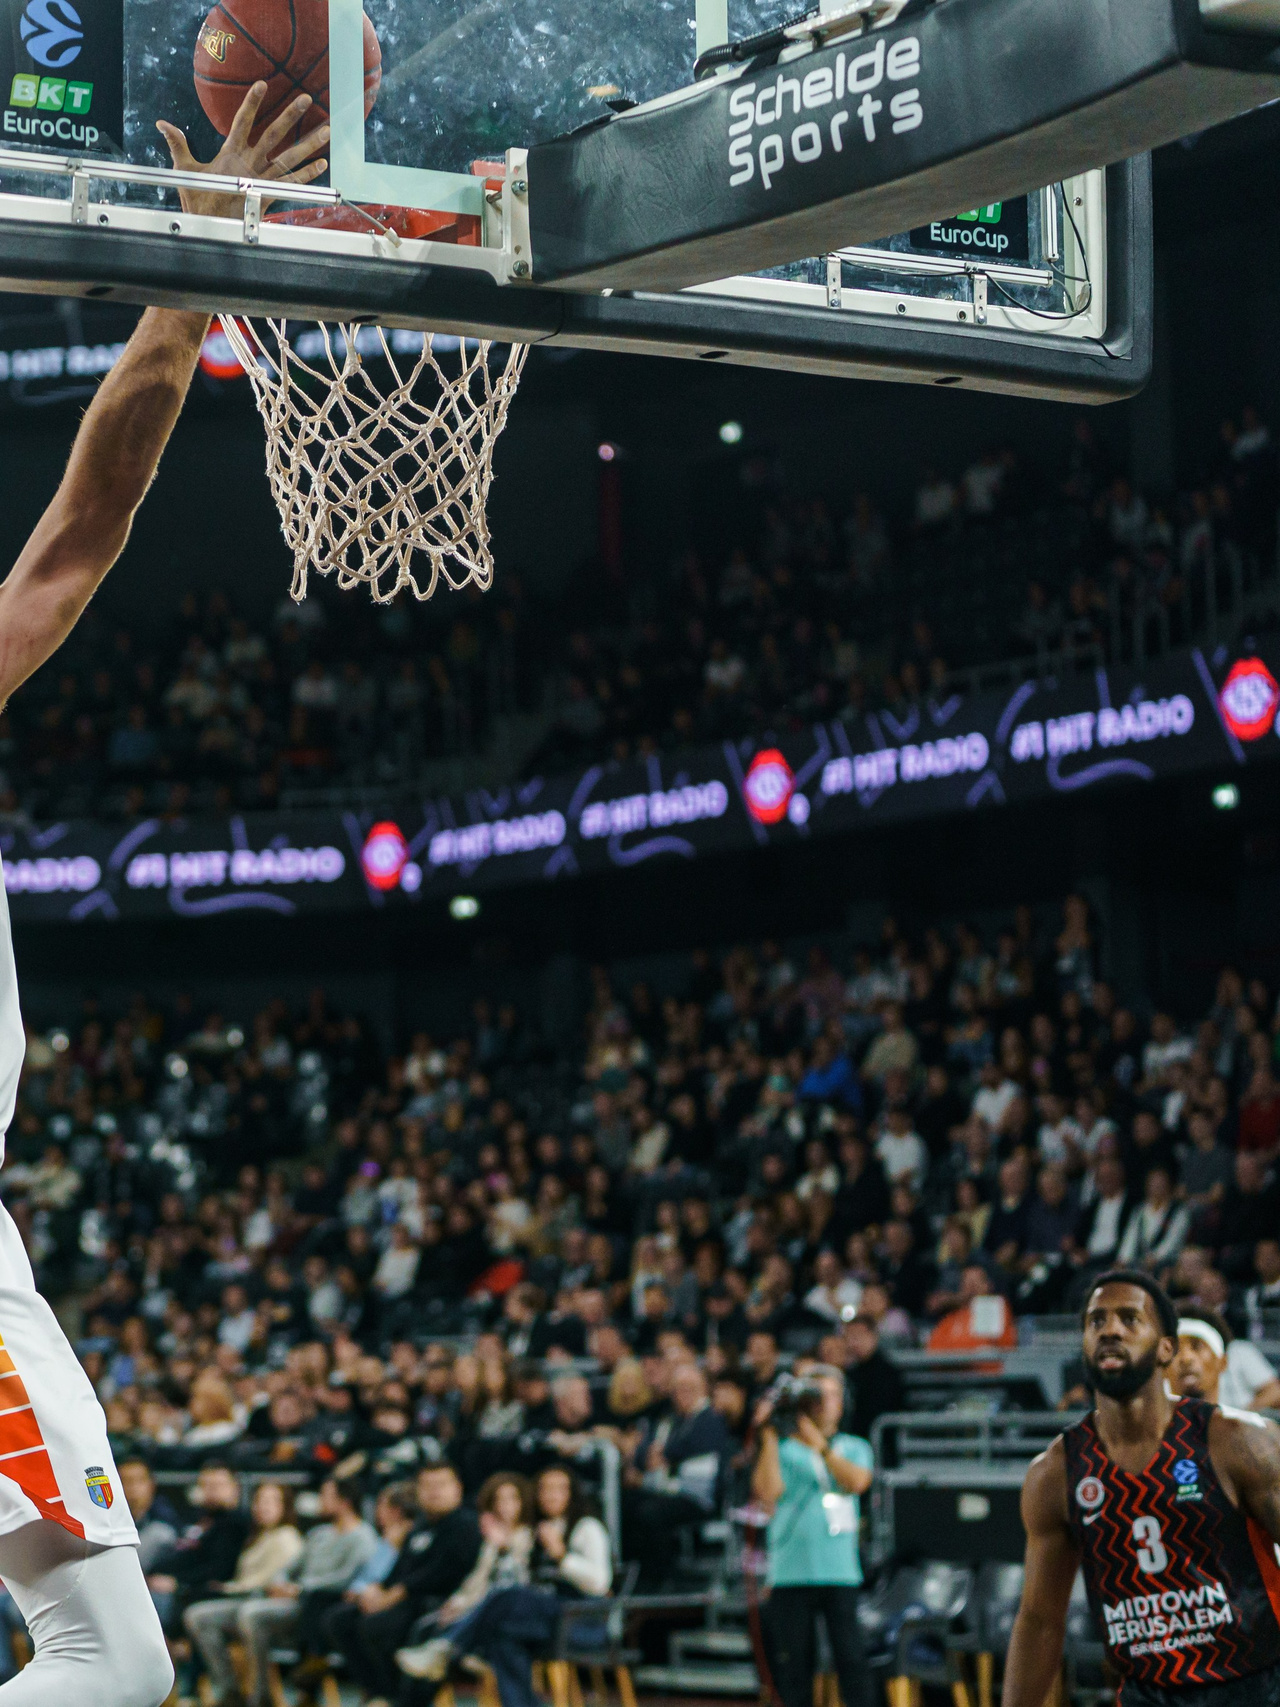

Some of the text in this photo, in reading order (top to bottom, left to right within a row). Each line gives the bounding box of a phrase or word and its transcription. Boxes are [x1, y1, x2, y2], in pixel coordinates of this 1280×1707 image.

[13, 79, 90, 108] BKT
[729, 36, 920, 136] Schelde
[3, 110, 99, 147] EuroCup
[729, 87, 923, 190] Sports
[930, 222, 1009, 253] EuroCup
[1132, 1515, 1168, 1575] 3
[1103, 1582, 1228, 1623] MIDTOWN
[1107, 1602, 1233, 1646] JERUSALEM
